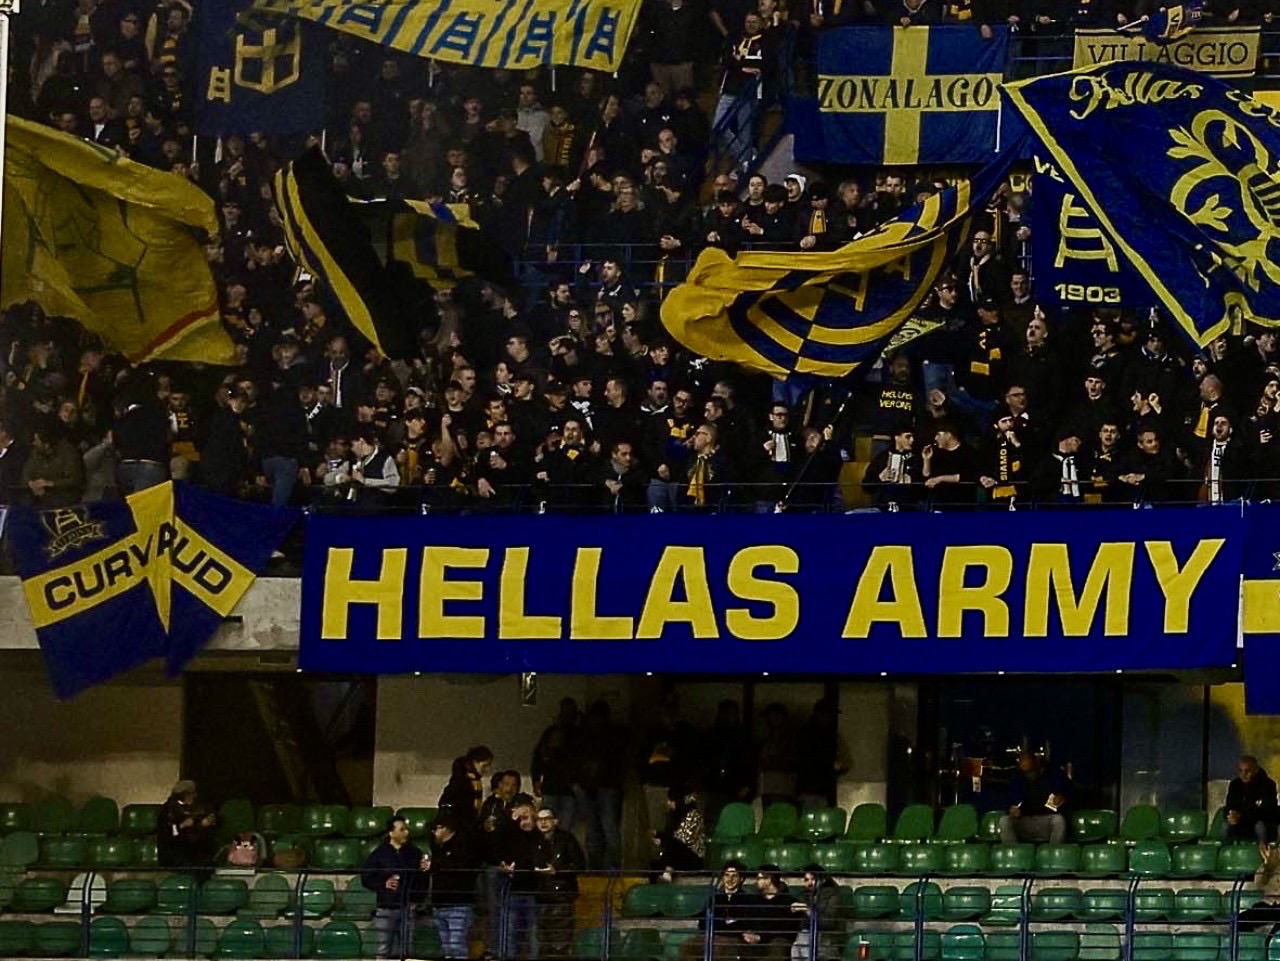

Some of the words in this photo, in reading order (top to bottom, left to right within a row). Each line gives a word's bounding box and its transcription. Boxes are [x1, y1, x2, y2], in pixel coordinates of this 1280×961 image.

[818, 77, 994, 109] ZONALAGO
[1054, 284, 1121, 303] 1903
[321, 544, 800, 640] HELLAS
[842, 538, 1225, 638] ARMY
